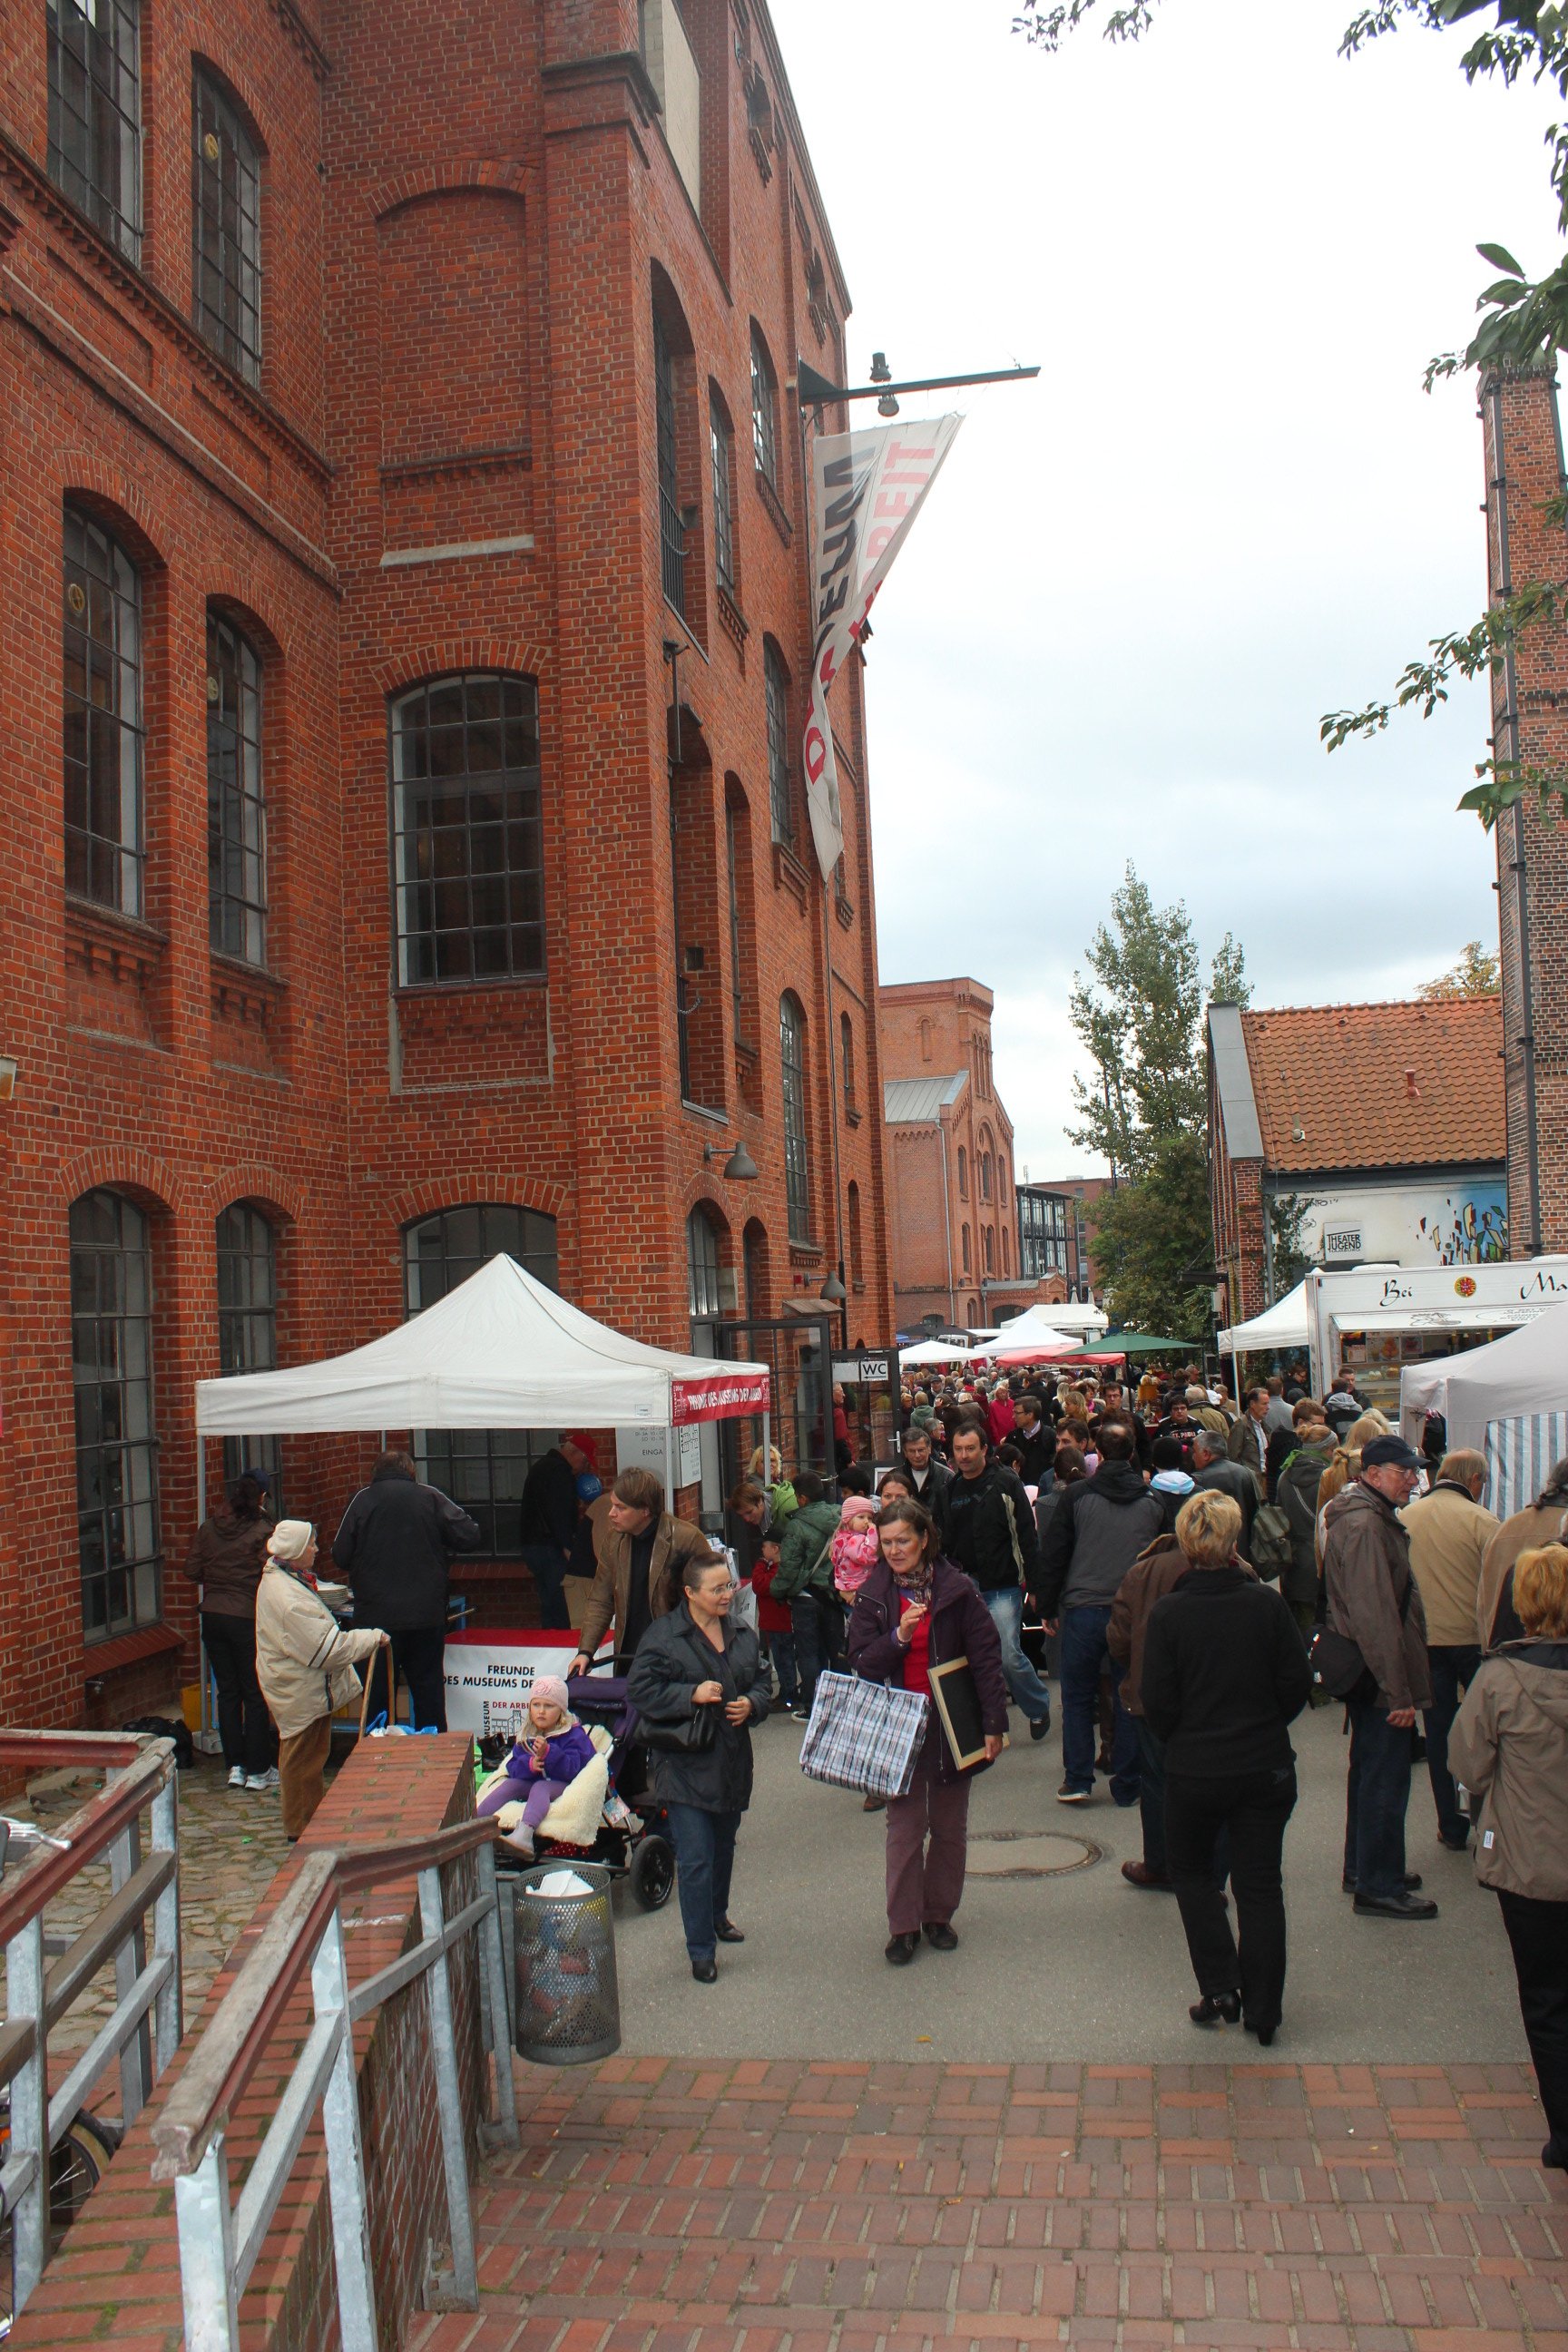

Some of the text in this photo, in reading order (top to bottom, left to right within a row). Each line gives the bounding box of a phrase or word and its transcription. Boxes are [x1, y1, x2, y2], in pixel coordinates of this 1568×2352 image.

[1327, 1232, 1360, 1242] THEATER
[1328, 1241, 1361, 1250] JUGEND
[1379, 1279, 1413, 1307] Bei
[862, 1363, 887, 1376] WC
[487, 1665, 535, 1676] FREUNDE
[463, 1677, 517, 1688] MUSEUMS
